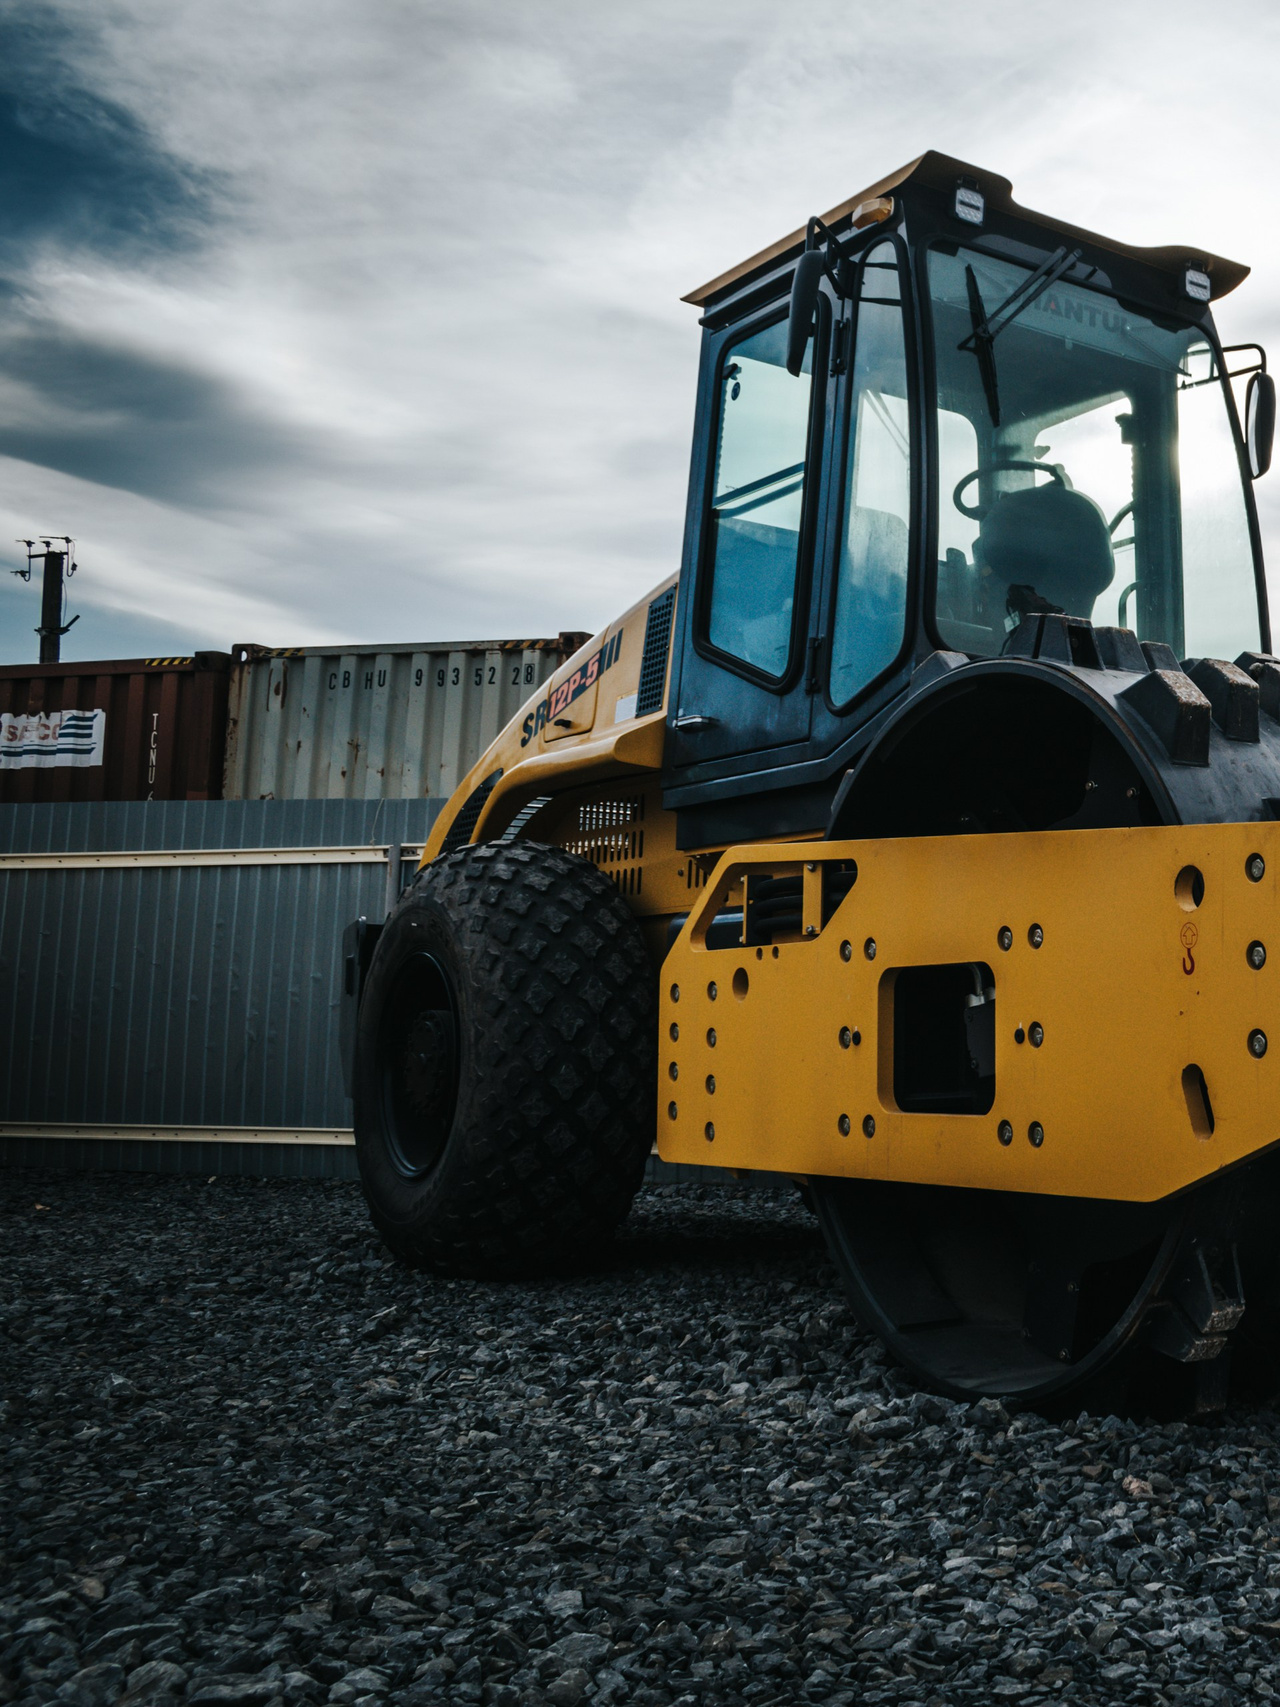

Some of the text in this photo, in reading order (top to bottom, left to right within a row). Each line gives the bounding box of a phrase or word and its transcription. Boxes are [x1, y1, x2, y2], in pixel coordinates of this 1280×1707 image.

[328, 664, 534, 690] CBHU 993522 8
[148, 713, 159, 784] TCNU
